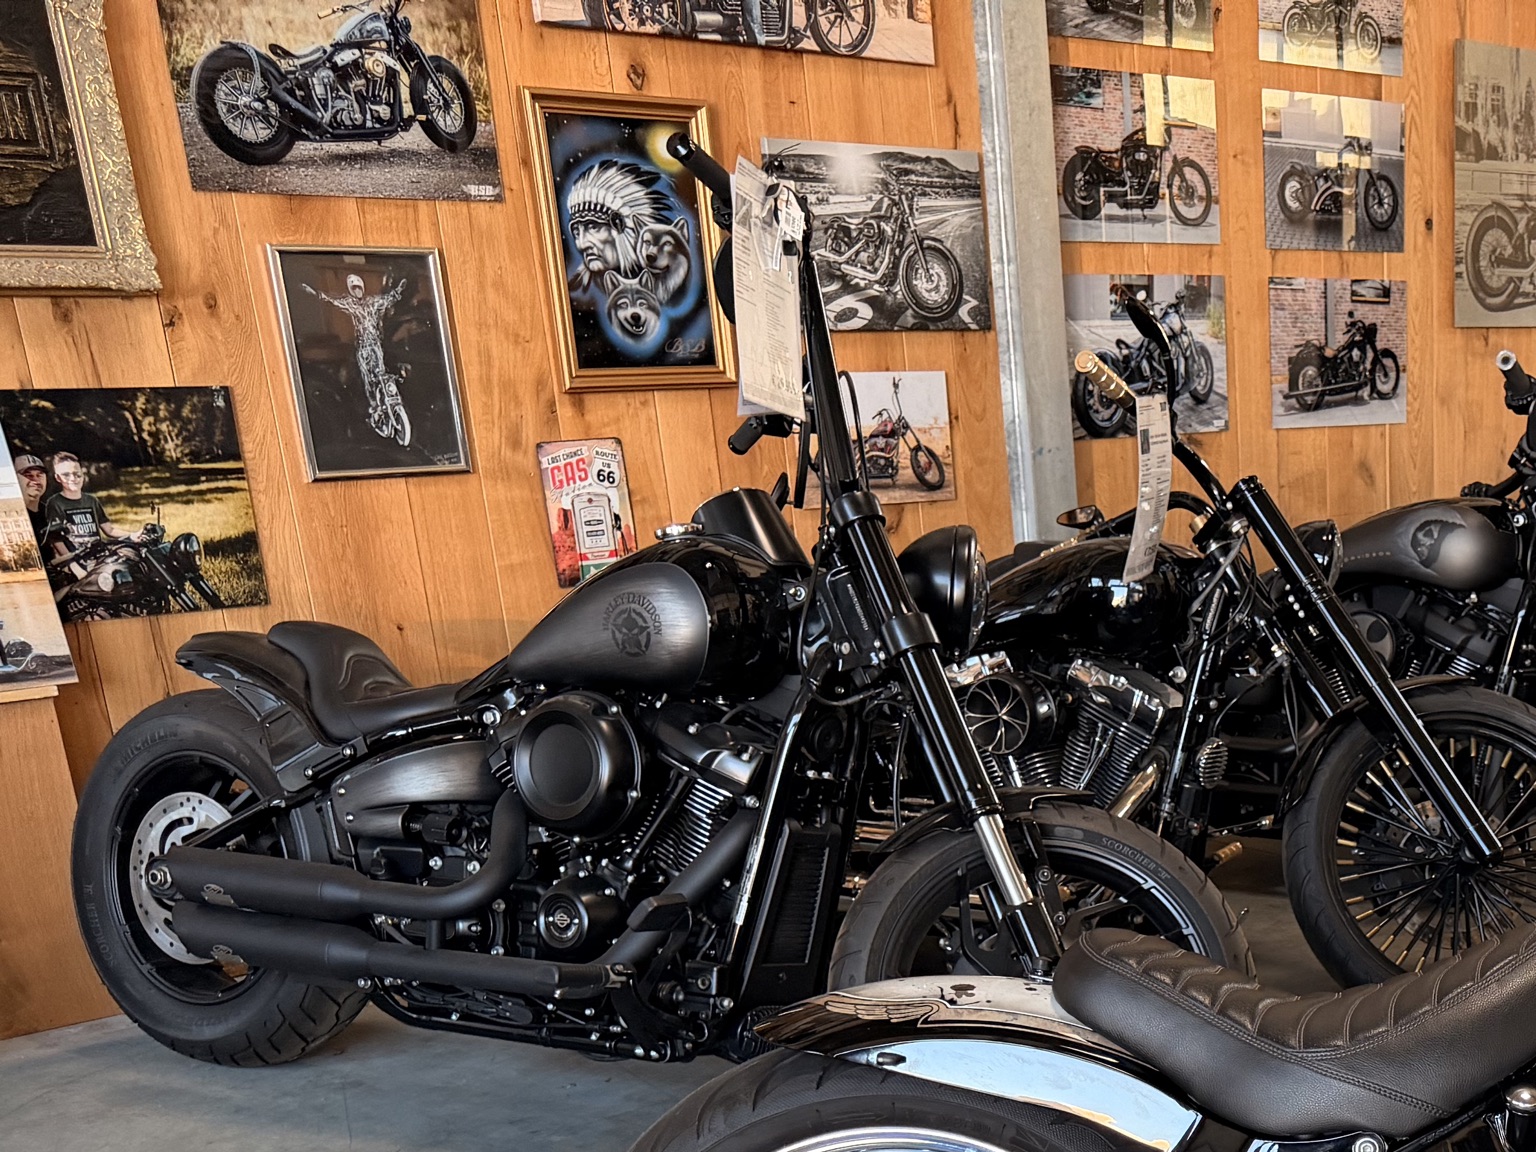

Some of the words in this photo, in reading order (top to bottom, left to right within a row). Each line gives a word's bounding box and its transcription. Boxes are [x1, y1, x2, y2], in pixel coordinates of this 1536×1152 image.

[547, 454, 562, 466] LAST
[562, 448, 585, 461] CHANCE
[595, 449, 618, 460] ROUTE
[550, 457, 589, 490] GAS
[596, 469, 616, 485] 66
[72, 513, 93, 524] WILD
[72, 522, 98, 534] YOUTH
[1102, 837, 1156, 870] SCORCHER
